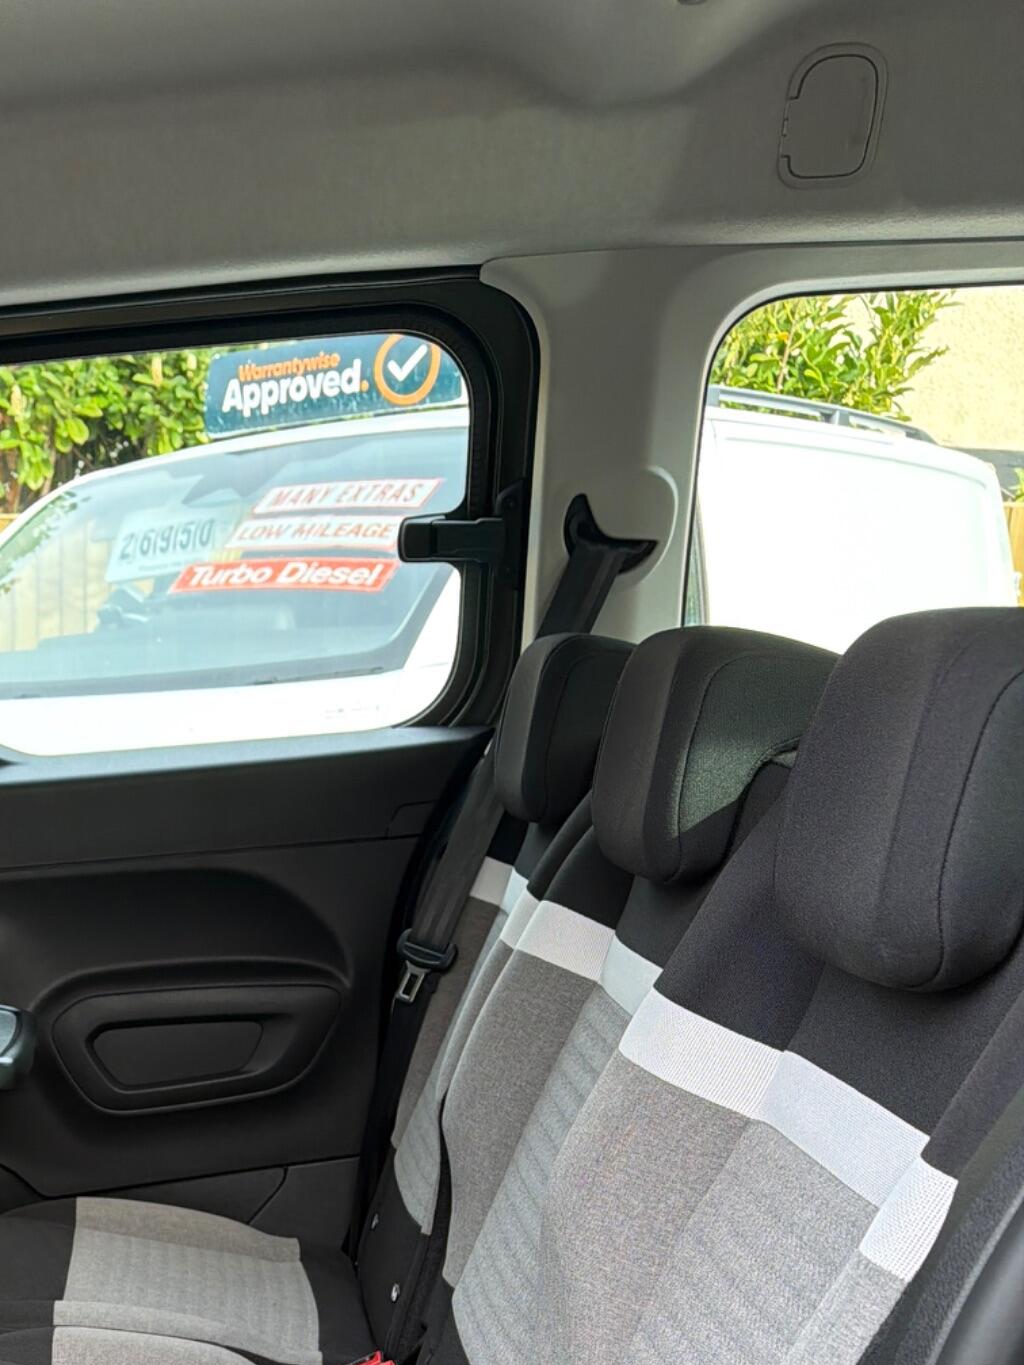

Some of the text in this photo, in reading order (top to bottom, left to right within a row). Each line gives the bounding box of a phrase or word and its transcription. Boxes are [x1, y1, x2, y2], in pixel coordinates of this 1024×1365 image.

[239, 351, 339, 381] Warrantywise
[222, 358, 369, 418] Approved.
[273, 482, 423, 508] MANY EXTRAS
[237, 522, 396, 541] LOW MILEAGE
[188, 561, 385, 587] Turbo Diesel
